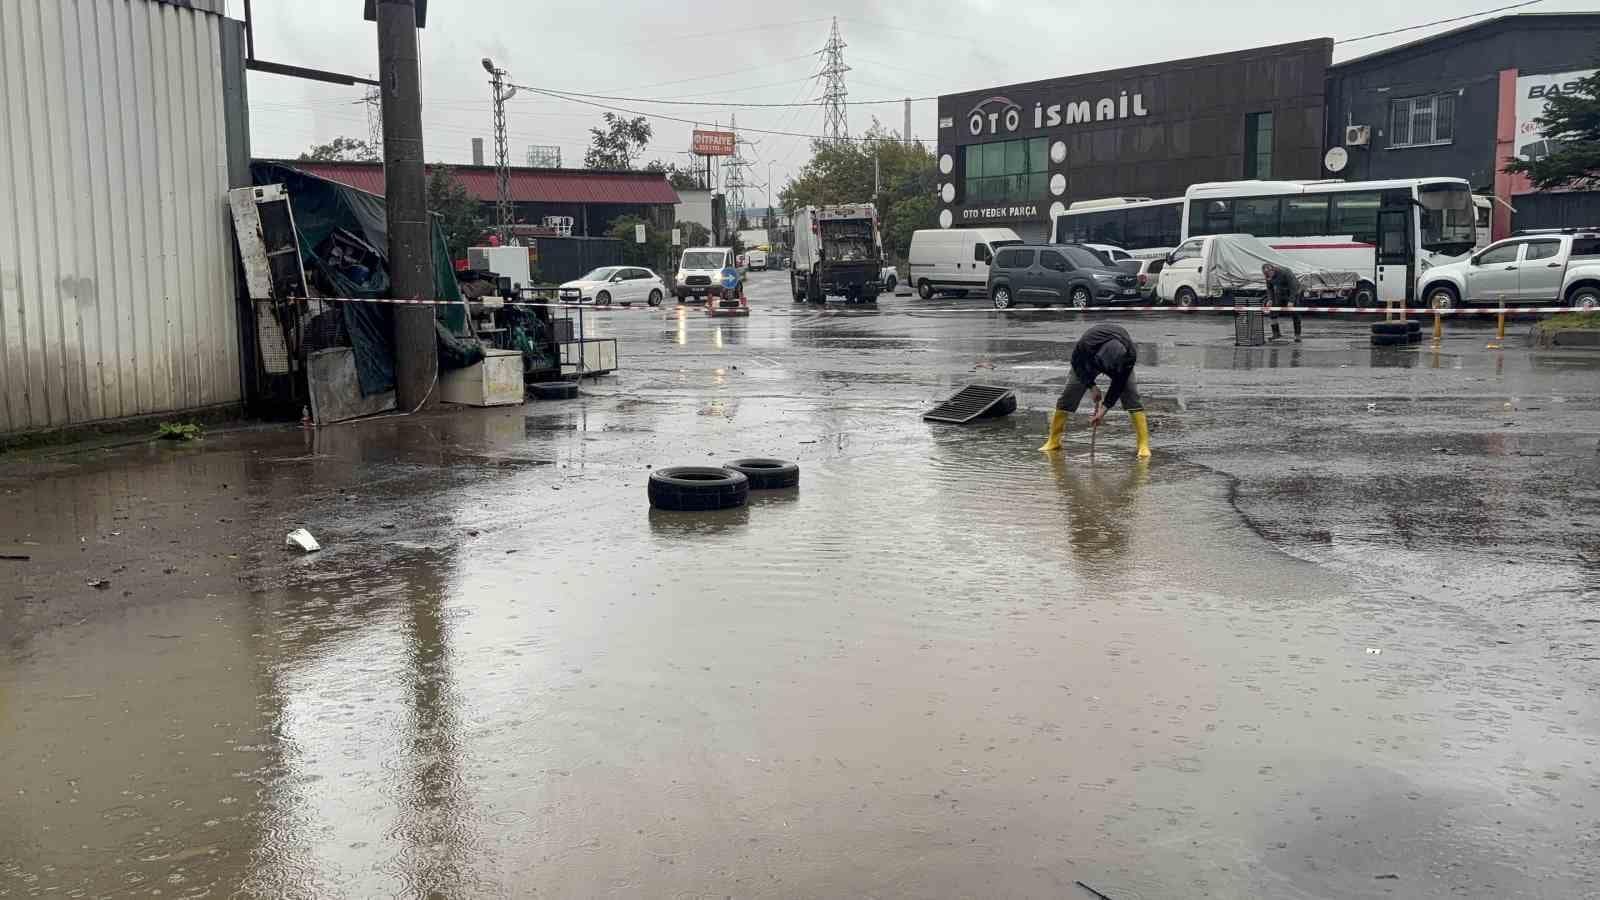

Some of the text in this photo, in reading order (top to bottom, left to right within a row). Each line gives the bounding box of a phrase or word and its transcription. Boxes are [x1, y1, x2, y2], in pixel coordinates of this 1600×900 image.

[969, 90, 1148, 135] OTO İSMAİL
[963, 205, 1037, 218] OTO YEDEK PARÇA
